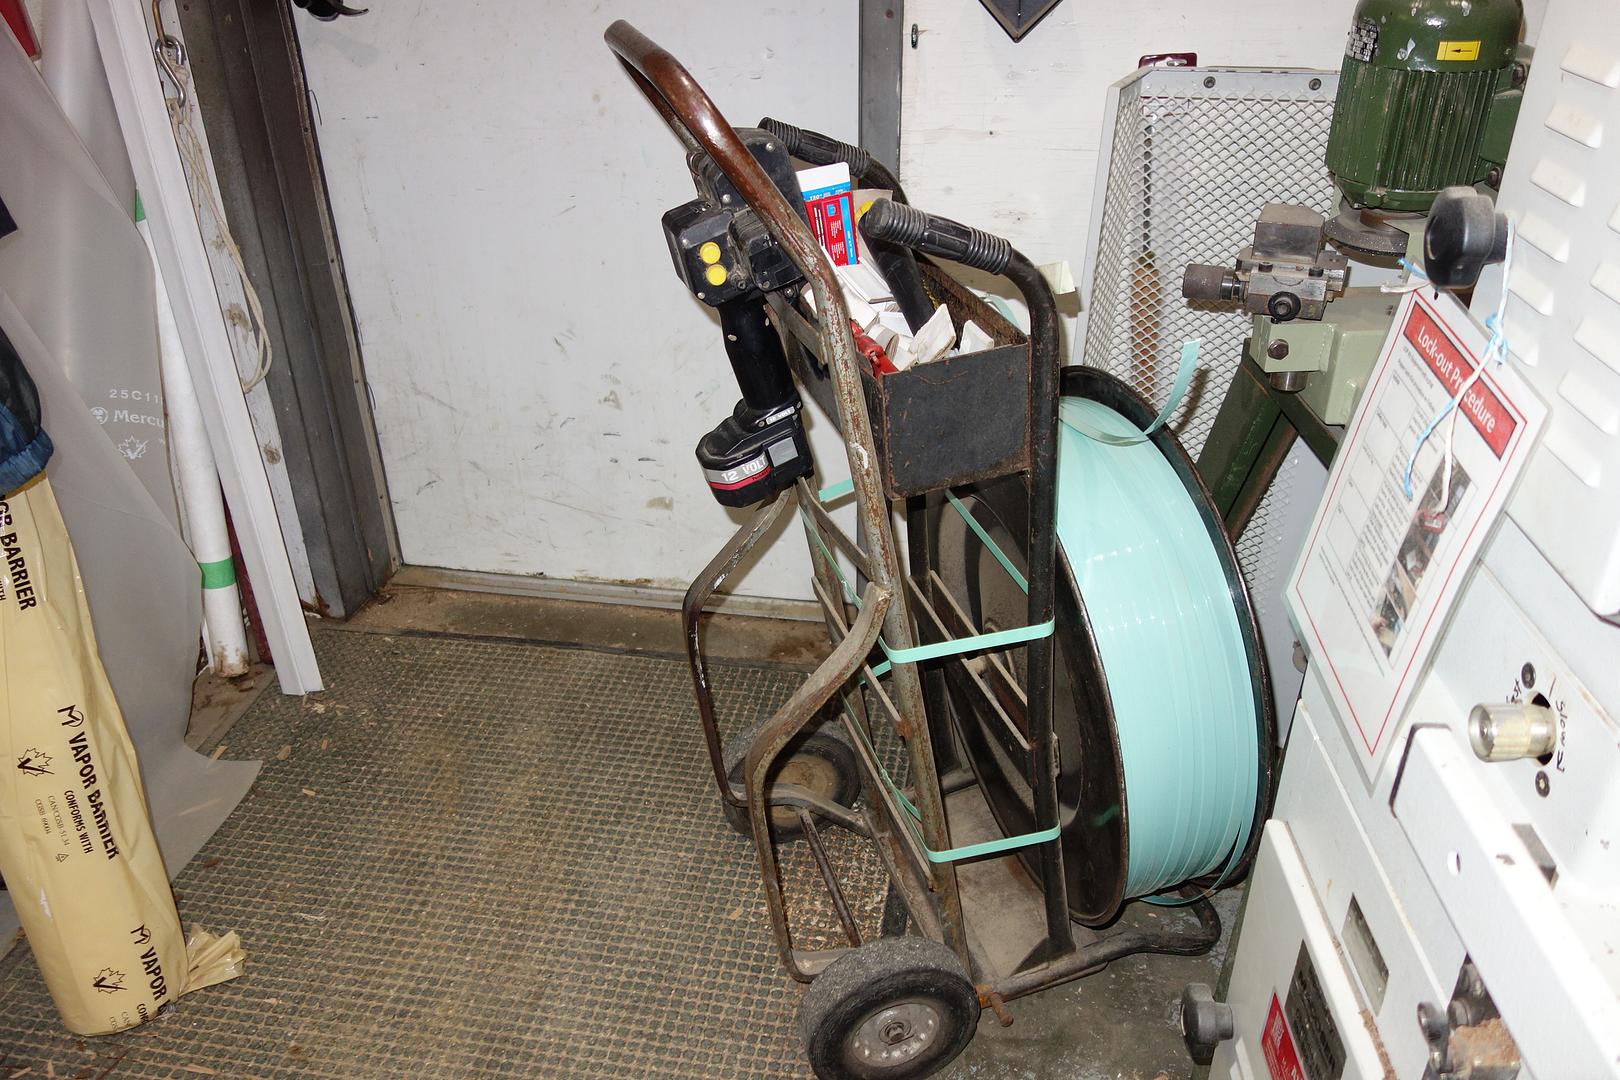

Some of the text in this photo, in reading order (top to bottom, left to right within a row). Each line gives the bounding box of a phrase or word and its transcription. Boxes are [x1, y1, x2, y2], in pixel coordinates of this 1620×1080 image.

[1417, 326, 1453, 378] Lock-out
[720, 470, 739, 482] 12
[742, 454, 768, 475] VOLT
[1, 532, 37, 611] BARRIER
[64, 790, 94, 854] CONFORMS WITH
[69, 731, 97, 789] VAPOR
[87, 789, 120, 860] BARRIER
[140, 946, 168, 1001] VAPOR
